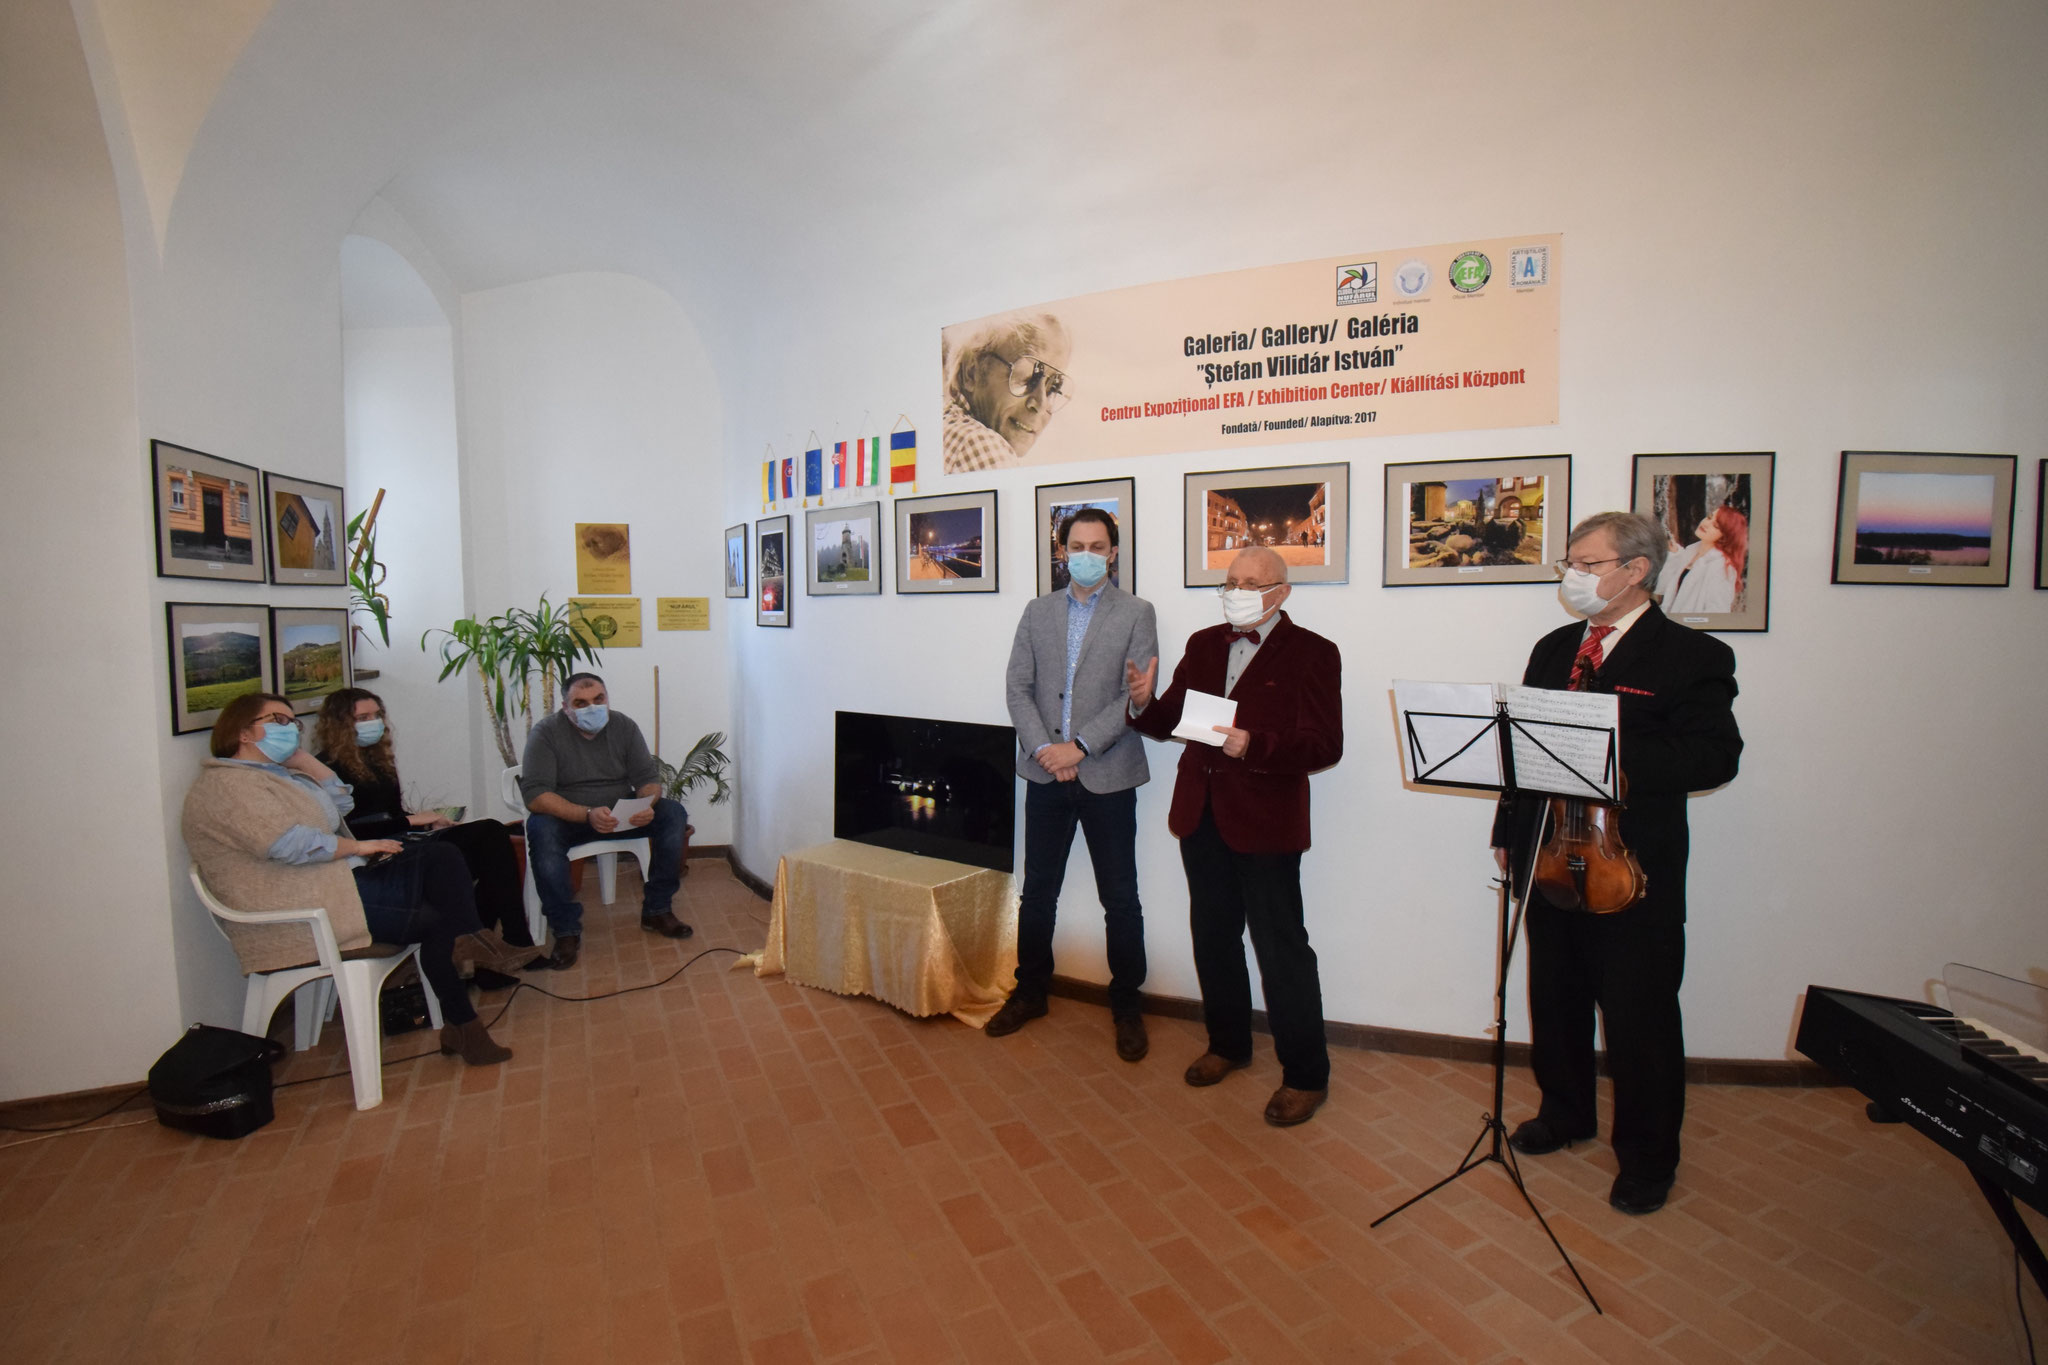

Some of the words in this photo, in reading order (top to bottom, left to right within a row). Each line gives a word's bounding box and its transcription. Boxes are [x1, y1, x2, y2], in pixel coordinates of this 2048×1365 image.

[1183, 328, 1257, 357] Galeria/
[1261, 319, 1338, 348] Gallery/
[1347, 313, 1419, 340] Galéria
[1266, 351, 1330, 378] Vilidár
[1101, 404, 1142, 422] Centru
[1144, 394, 1220, 418] Expozițional
[1223, 391, 1245, 409] EFA
[1257, 385, 1327, 406] Exhibition
[1330, 378, 1387, 400] Center/
[1390, 372, 1460, 394] Kiállítási
[1463, 368, 1526, 388] Központ
[1221, 420, 1262, 435] Fondată/
[1264, 416, 1309, 431] Founded/
[1310, 413, 1353, 428] Alapítva:
[1354, 411, 1377, 424] 2017
